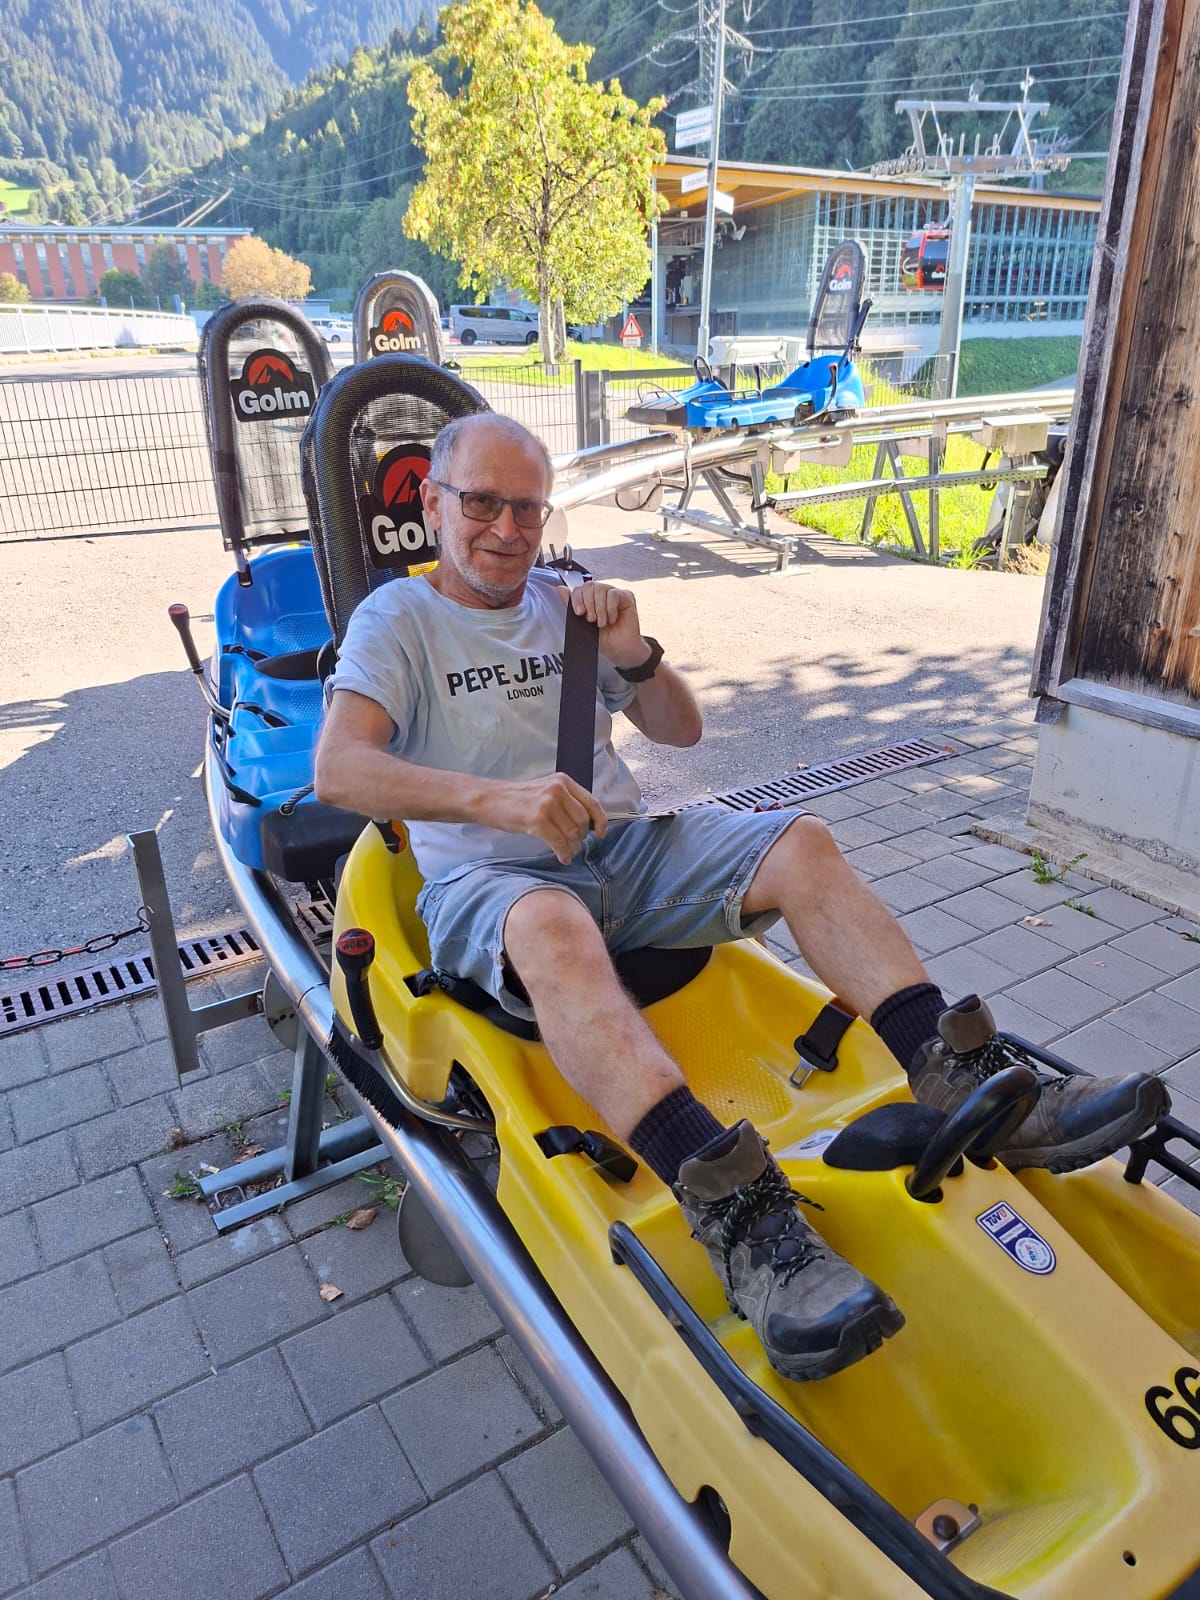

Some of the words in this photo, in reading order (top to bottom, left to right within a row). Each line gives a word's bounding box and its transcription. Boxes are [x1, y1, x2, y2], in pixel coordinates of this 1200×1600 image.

[374, 333, 421, 352] Golm
[238, 387, 310, 415] Golm
[371, 510, 442, 555] Gol
[446, 664, 511, 697] PEPE
[507, 685, 544, 701] LONDON
